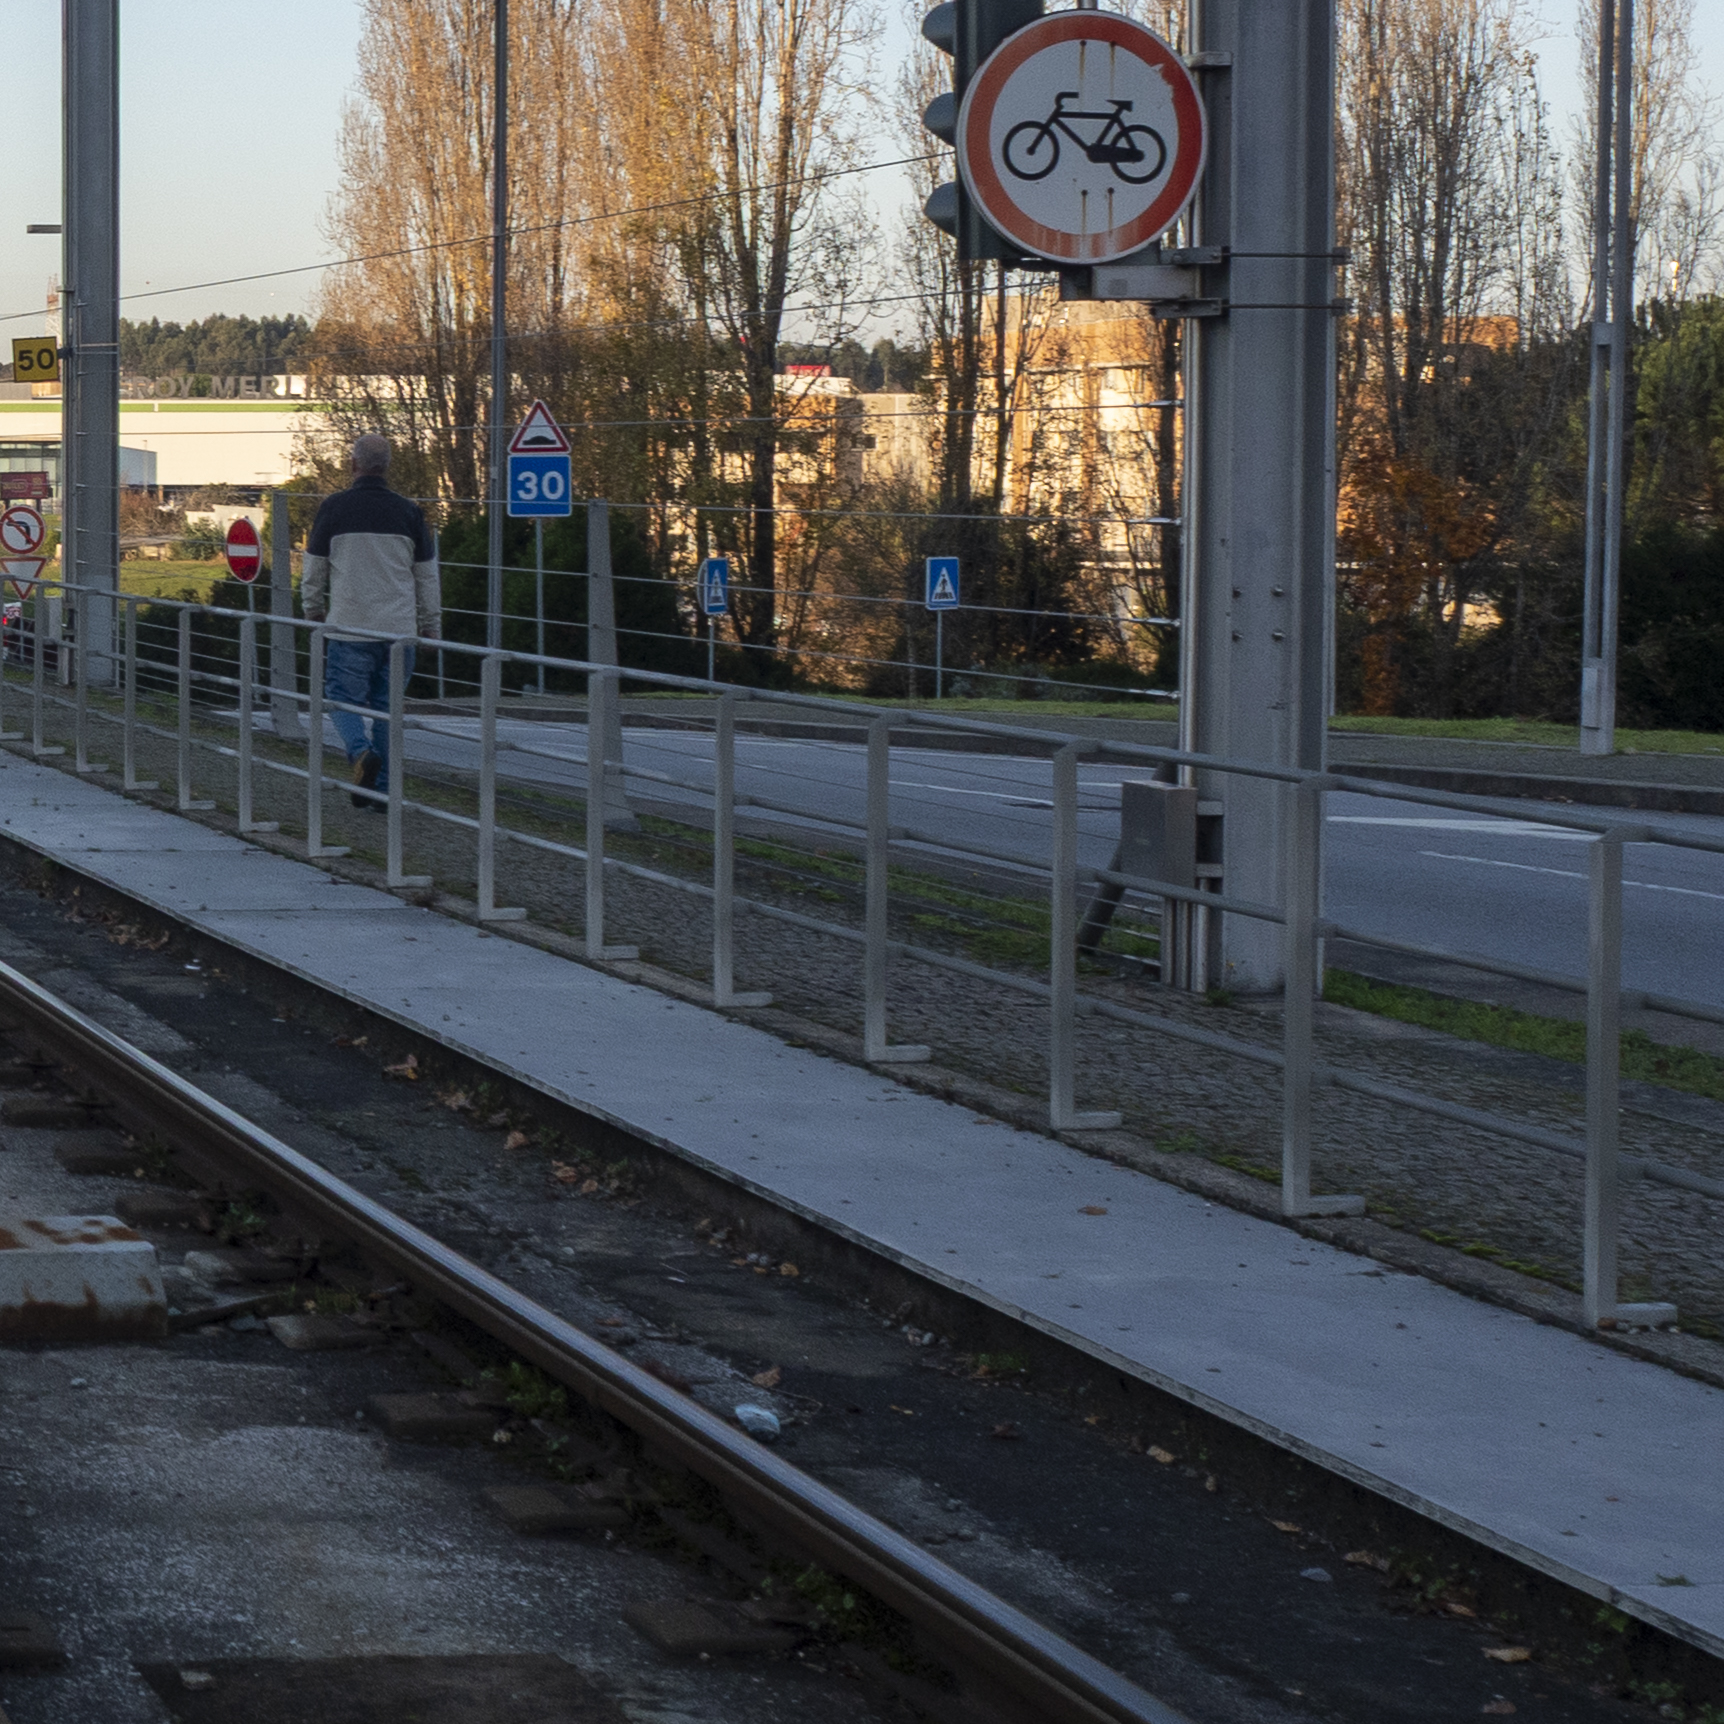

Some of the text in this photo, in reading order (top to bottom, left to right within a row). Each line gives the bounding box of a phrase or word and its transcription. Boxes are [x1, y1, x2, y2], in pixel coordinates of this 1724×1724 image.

[18, 348, 54, 372] 50
[119, 375, 194, 399] ROY
[517, 471, 565, 500] 30
